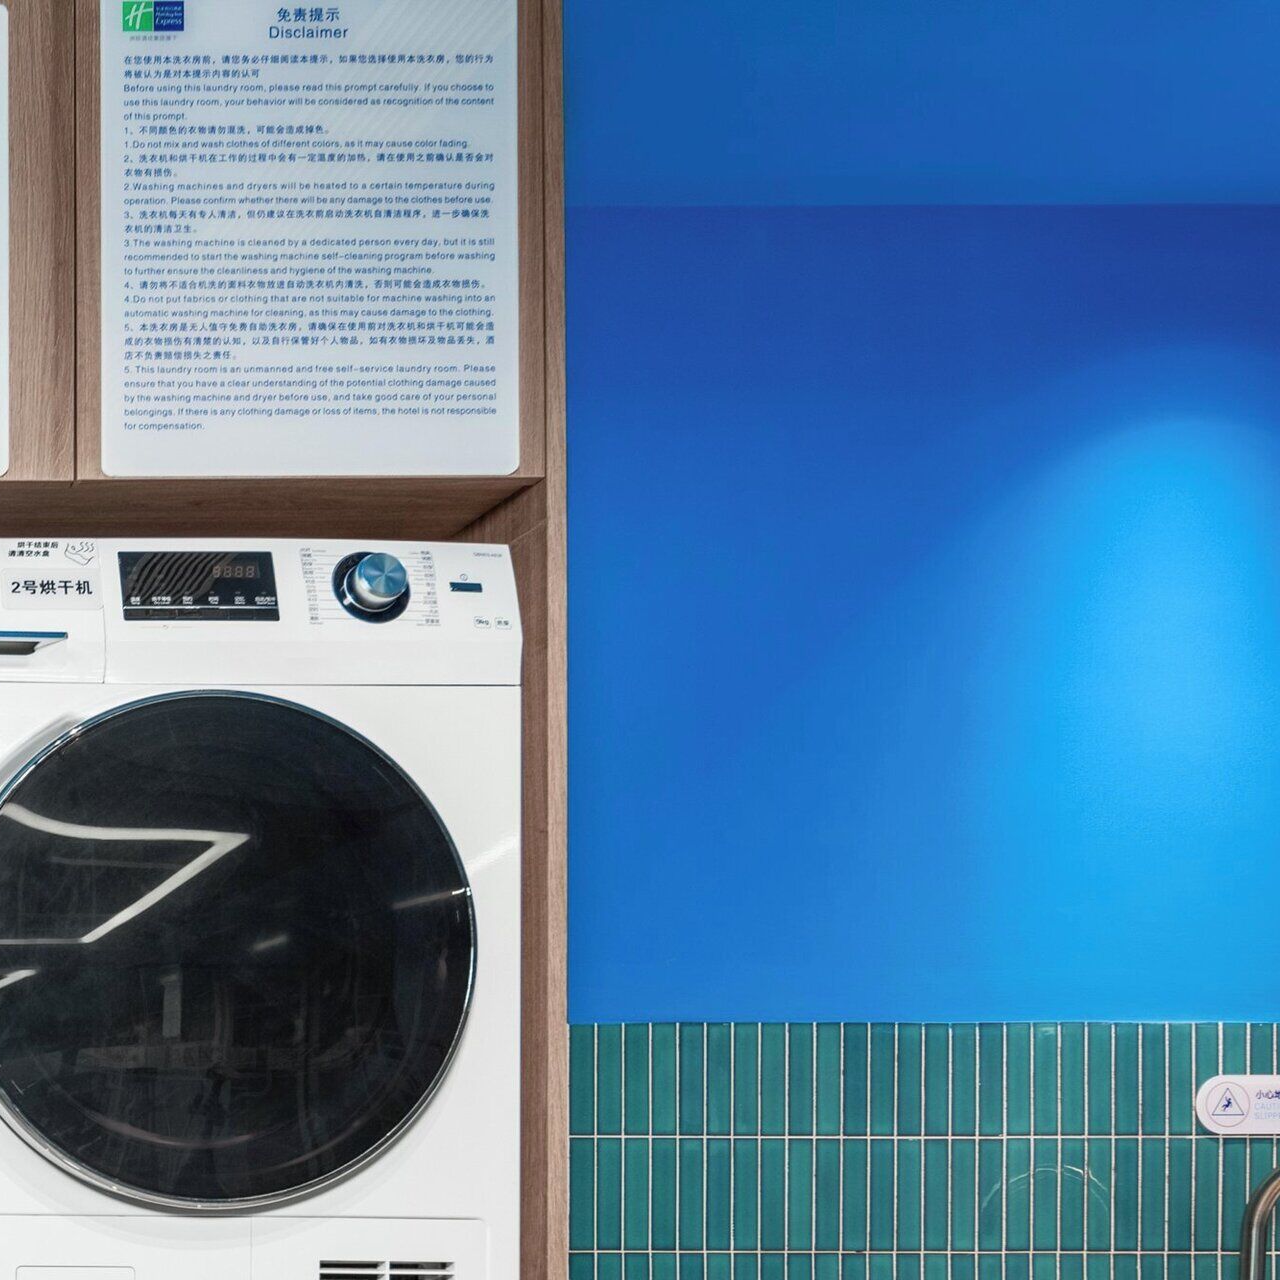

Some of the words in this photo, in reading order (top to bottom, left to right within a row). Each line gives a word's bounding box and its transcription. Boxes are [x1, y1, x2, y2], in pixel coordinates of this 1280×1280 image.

[277, 8, 340, 22] 免责提示
[269, 26, 348, 39] Disclaimer
[123, 84, 154, 92] Before
[156, 84, 182, 94] using
[203, 84, 238, 94] laundry
[268, 83, 300, 94] please
[344, 83, 377, 94] prompt
[424, 83, 431, 91] If
[432, 85, 449, 93] you
[450, 83, 484, 91] choose
[484, 83, 494, 91] to
[125, 140, 146, 148] 1.Do
[147, 140, 162, 148] not
[181, 140, 199, 148] and
[200, 140, 225, 148] wash
[226, 140, 260, 148] clothes
[357, 139, 363, 147] it
[364, 141, 384, 150] may
[414, 139, 438, 147] color
[124, 252, 189, 260] recommended
[190, 252, 200, 260] to
[224, 252, 239, 260] the
[240, 252, 279, 262] washing
[321, 252, 383, 262] self-cleaning
[384, 254, 424, 262] program
[424, 251, 456, 260] before
[457, 251, 496, 262] washing
[124, 422, 137, 430] for
[11, 580, 93, 595] 2号烘干机
